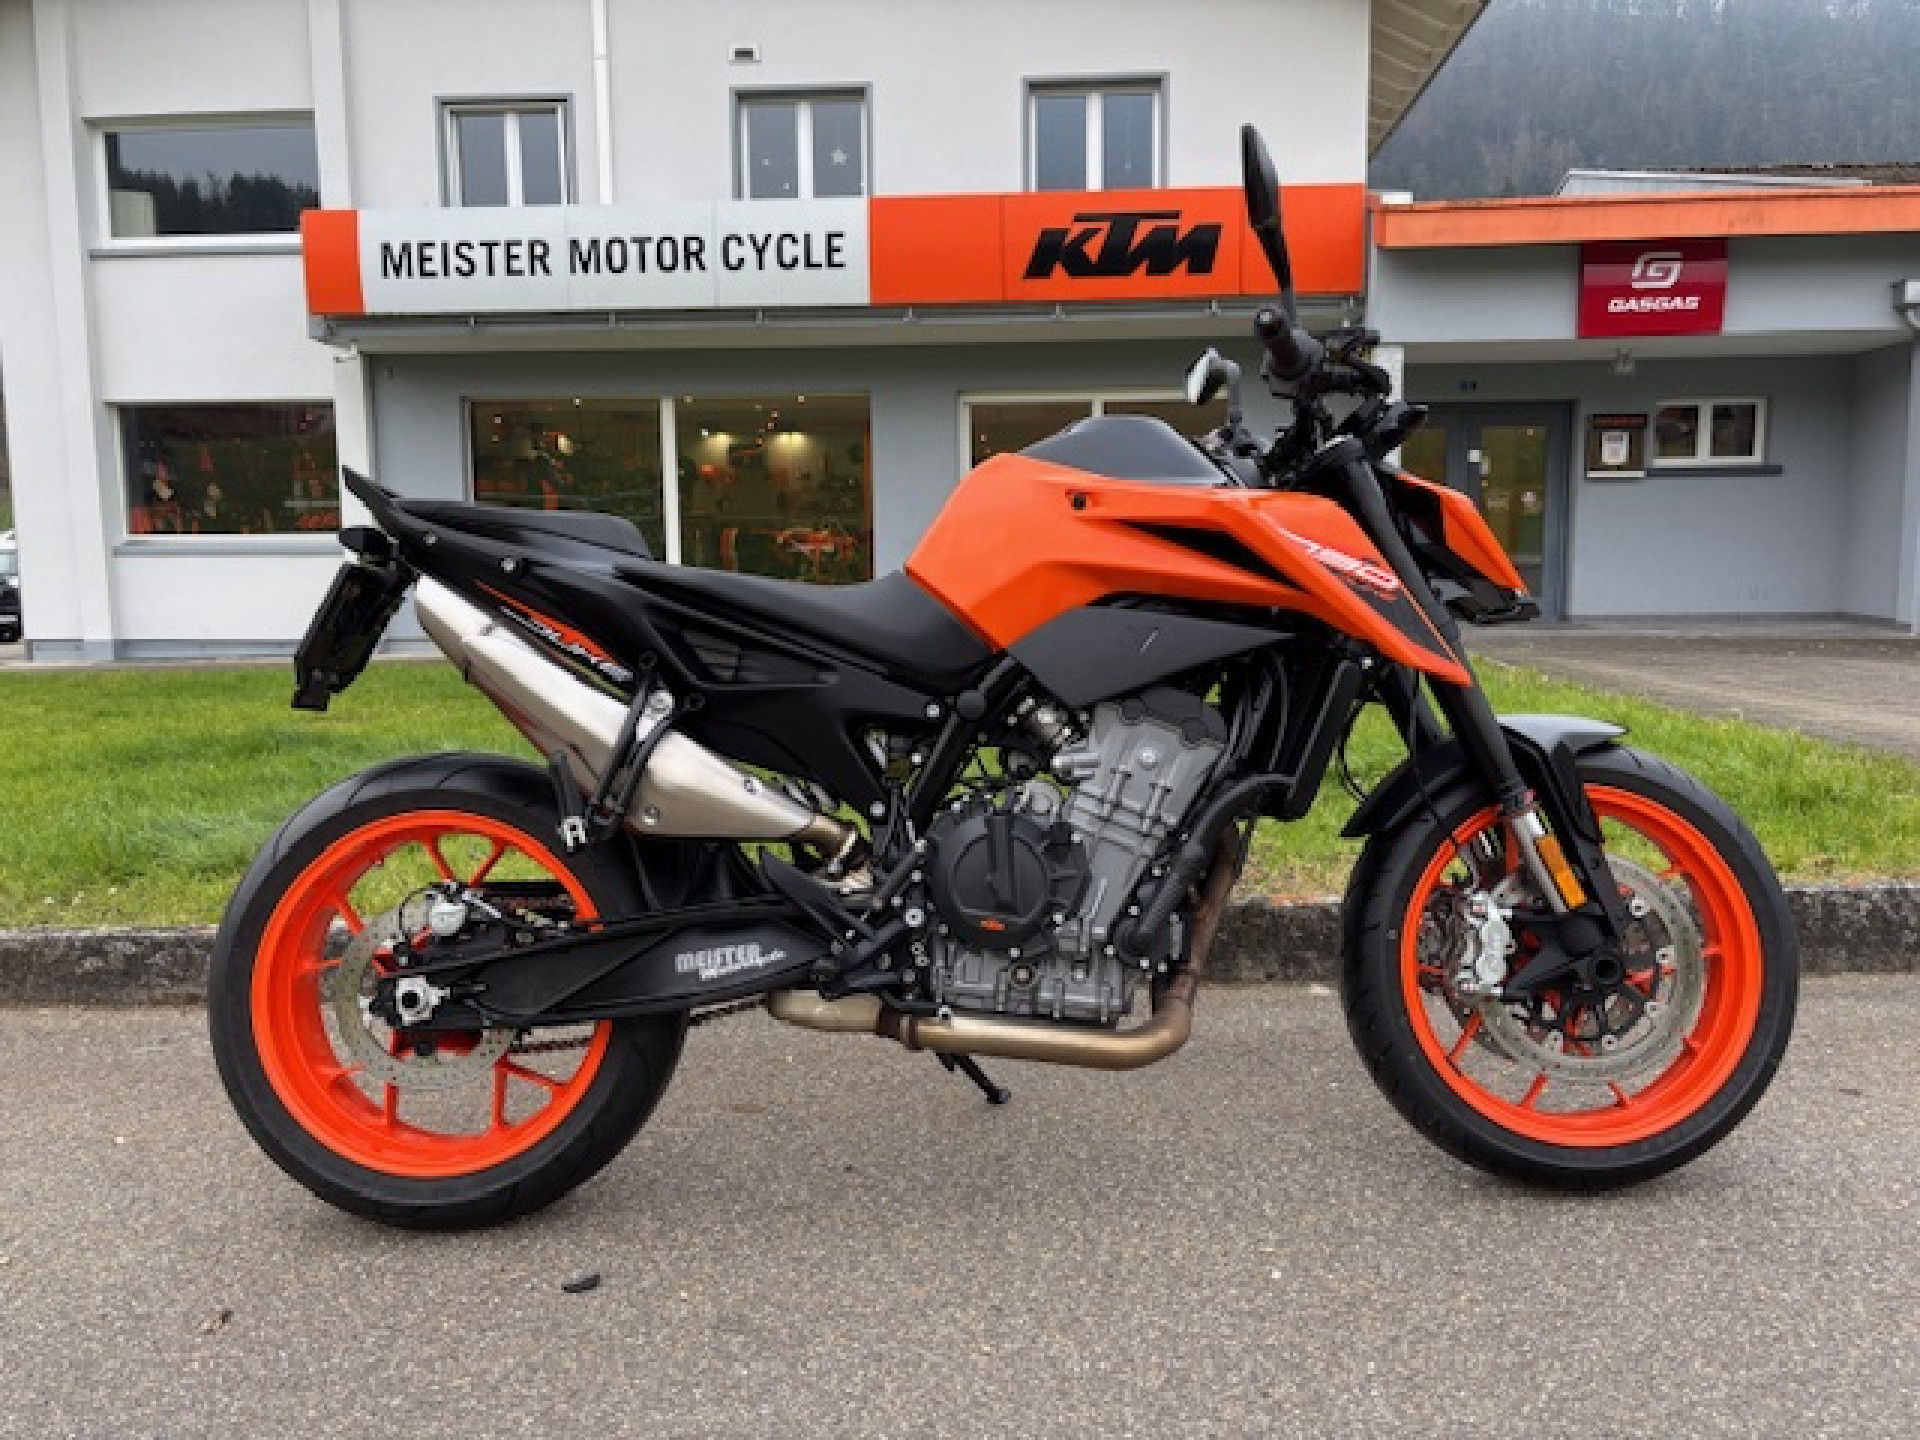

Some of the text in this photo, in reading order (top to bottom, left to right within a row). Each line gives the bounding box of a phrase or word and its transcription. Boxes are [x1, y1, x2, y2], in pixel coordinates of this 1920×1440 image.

[380, 231, 847, 279] MEISTER MOTOR CYCLE
[1023, 210, 1223, 279] KTM
[1607, 296, 1702, 313] GASGAS
